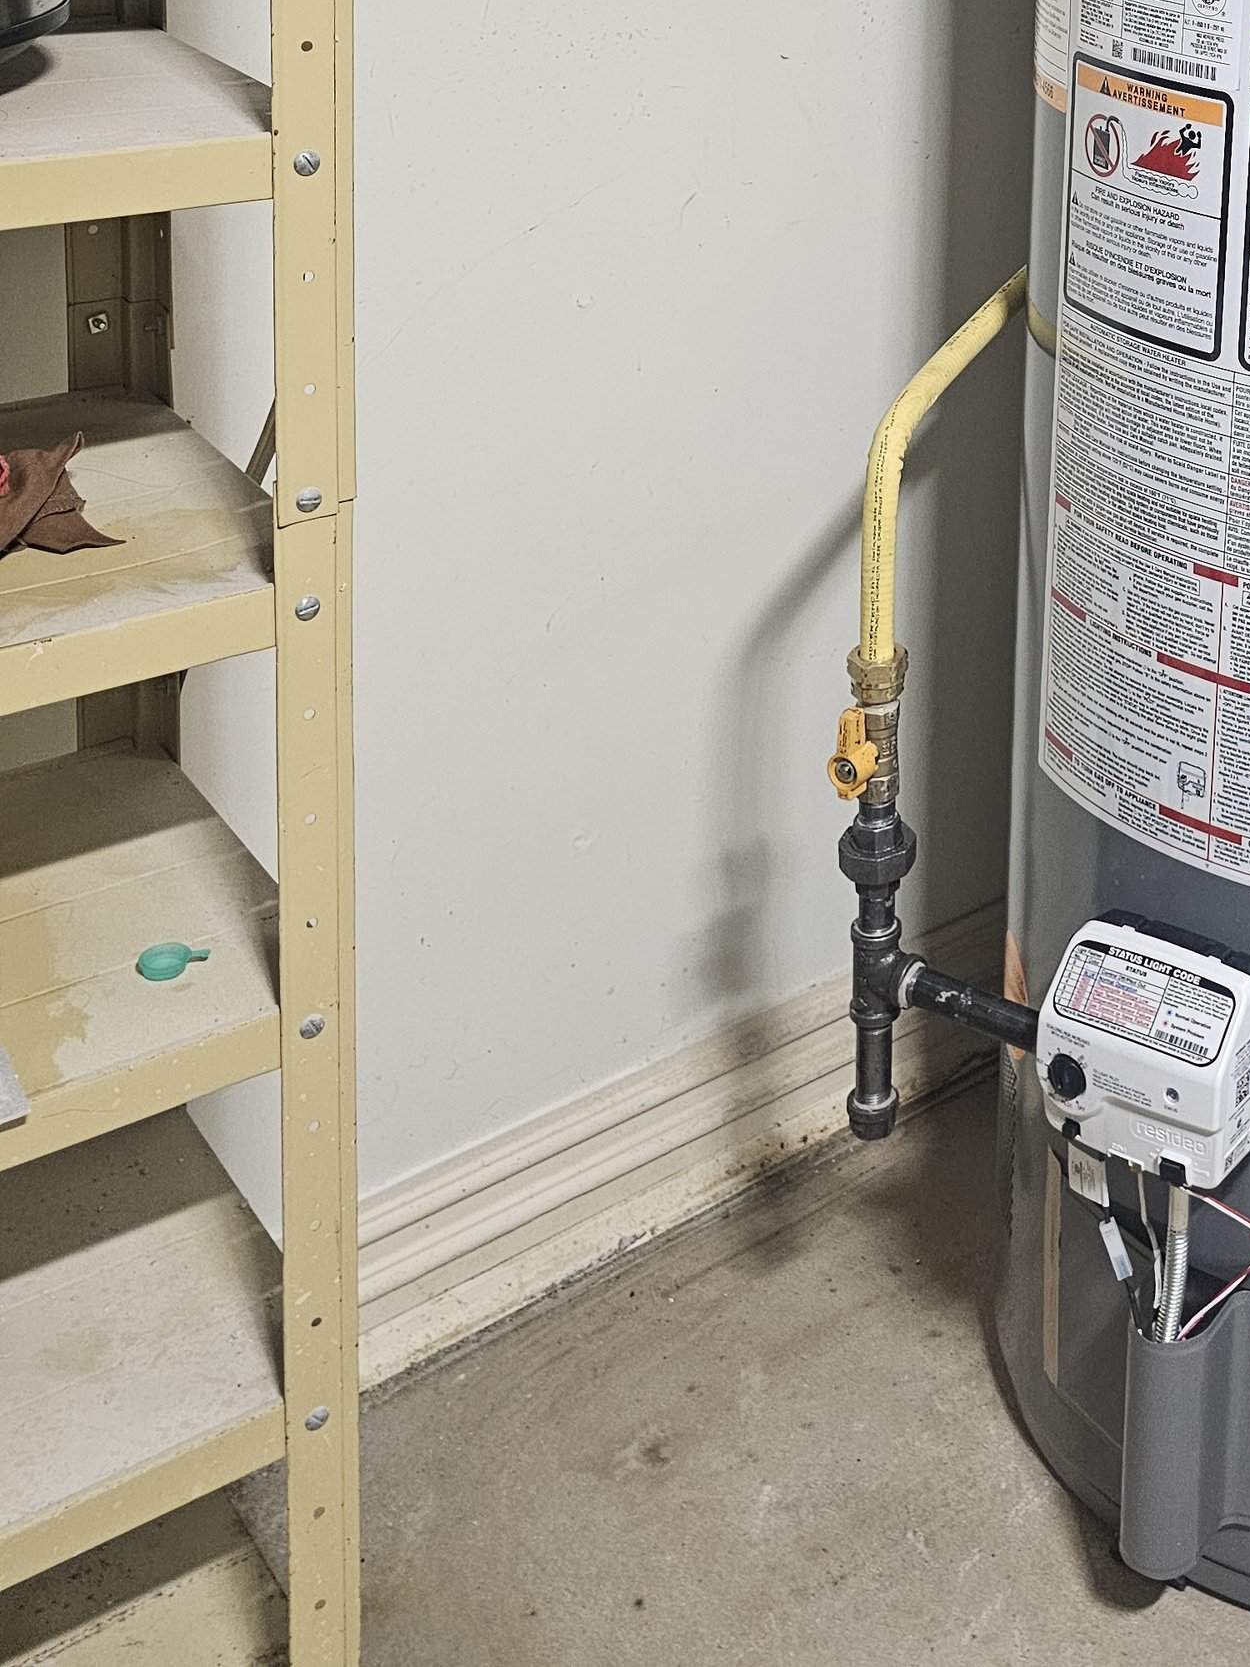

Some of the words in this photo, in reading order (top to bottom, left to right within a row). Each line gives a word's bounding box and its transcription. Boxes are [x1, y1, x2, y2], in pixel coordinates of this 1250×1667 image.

[1113, 89, 1185, 117] AVERTISSEMENT
[1127, 83, 1168, 102] WARNING
[1095, 186, 1106, 197] FIRE
[1108, 190, 1118, 201] AND
[1119, 194, 1151, 212] EXPLOSION
[1153, 206, 1180, 221] HAZARD
[1122, 203, 1140, 216] serious
[1142, 209, 1157, 224] injury
[1160, 217, 1165, 225] or
[1168, 219, 1184, 230] death
[1136, 259, 1143, 269] ET
[1145, 263, 1187, 284] D'EXPLOSION
[1156, 276, 1176, 289] graves
[1188, 284, 1194, 293] la
[1196, 288, 1211, 298] mort
[1090, 323, 1116, 341] AUTOMATIC
[1116, 336, 1140, 351] STORAGE
[1141, 346, 1161, 359] WATER
[1162, 354, 1187, 366] HEATER
[1095, 522, 1114, 537] SAFETY
[1115, 532, 1129, 545] READ
[1130, 542, 1152, 555] BEFORE
[1154, 551, 1187, 570] OPERATING
[1112, 633, 1152, 657] INSTRUCTIONS
[1094, 770, 1104, 783] GAS
[1105, 777, 1115, 788] OFF
[1116, 784, 1123, 794] TO
[1125, 789, 1157, 811] APPLIANCE
[1108, 947, 1143, 965] STATUS
[1143, 958, 1173, 974] LIGHT
[1173, 969, 1202, 985] CODE
[1126, 965, 1147, 977] STATUS
[1137, 1121, 1206, 1154] resideo
